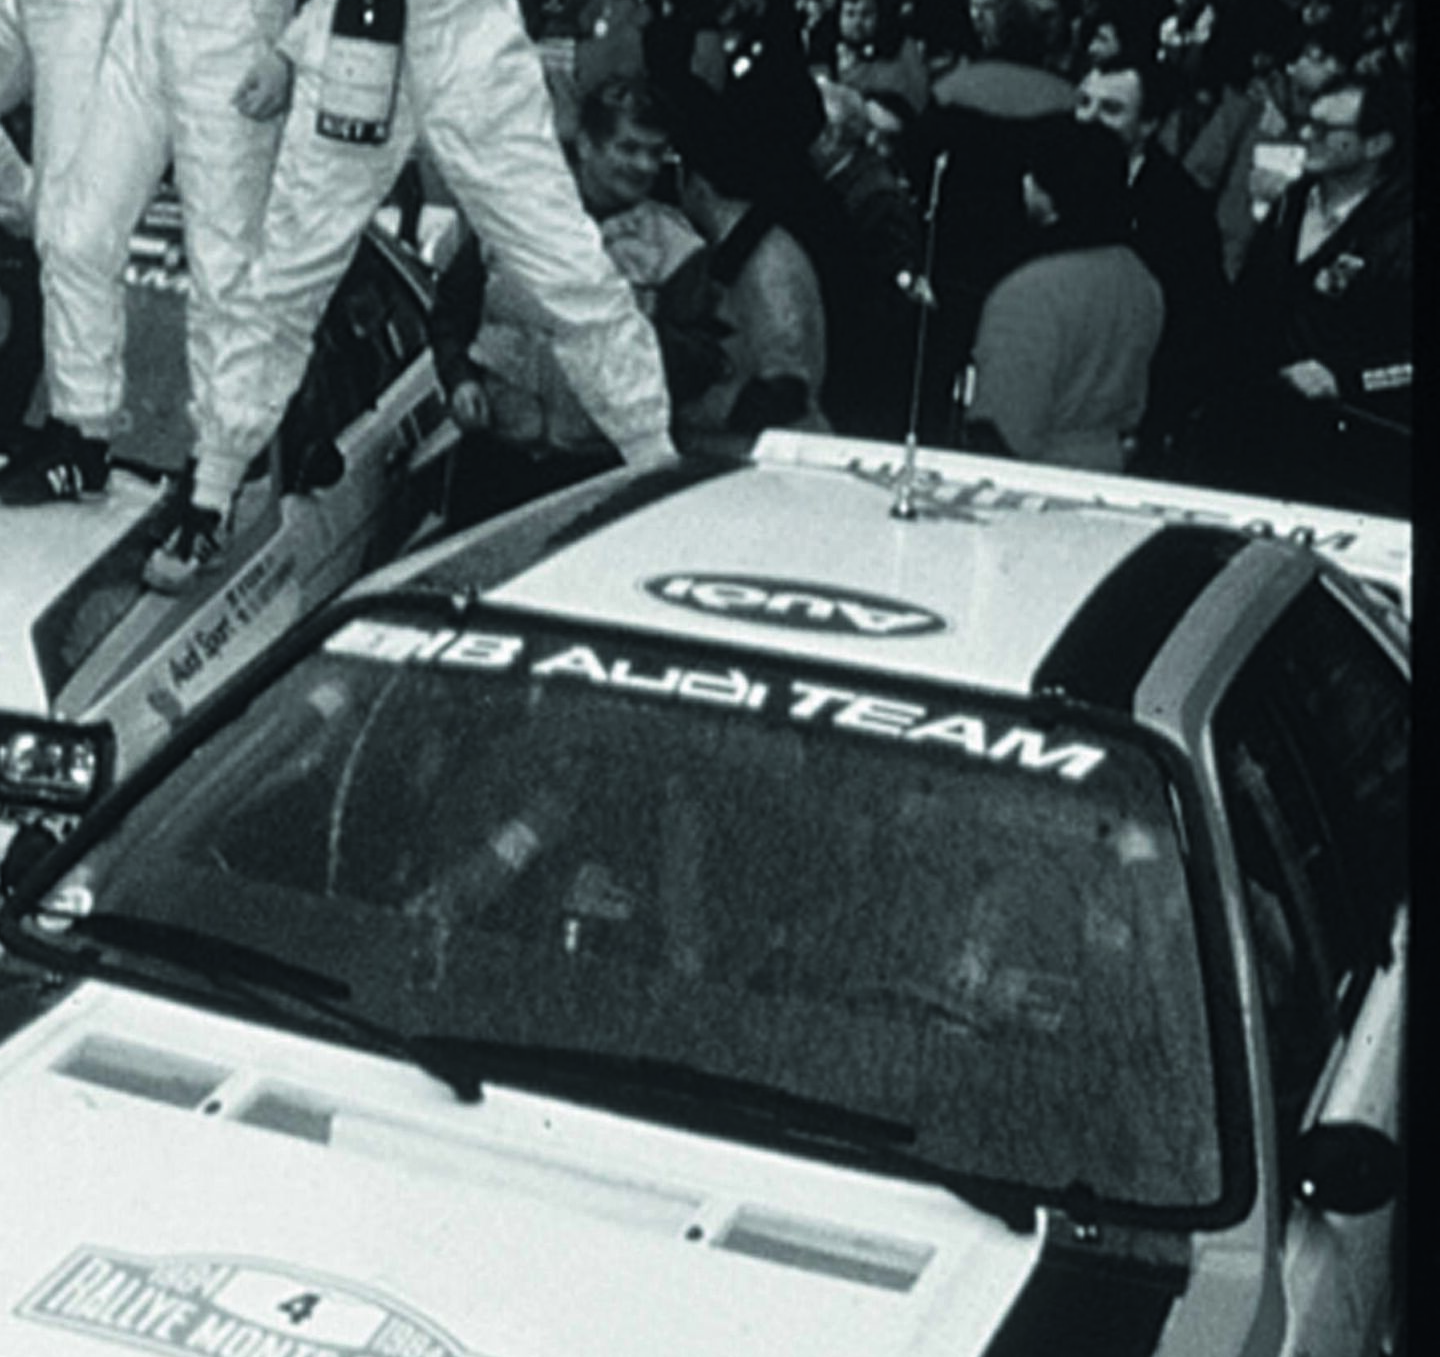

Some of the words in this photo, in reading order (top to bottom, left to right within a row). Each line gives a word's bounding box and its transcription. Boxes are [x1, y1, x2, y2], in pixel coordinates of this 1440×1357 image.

[532, 642, 768, 708] Audi
[788, 684, 1105, 781] TEAM
[46, 1257, 198, 1338] RALLYE
[278, 1291, 321, 1326] 4
